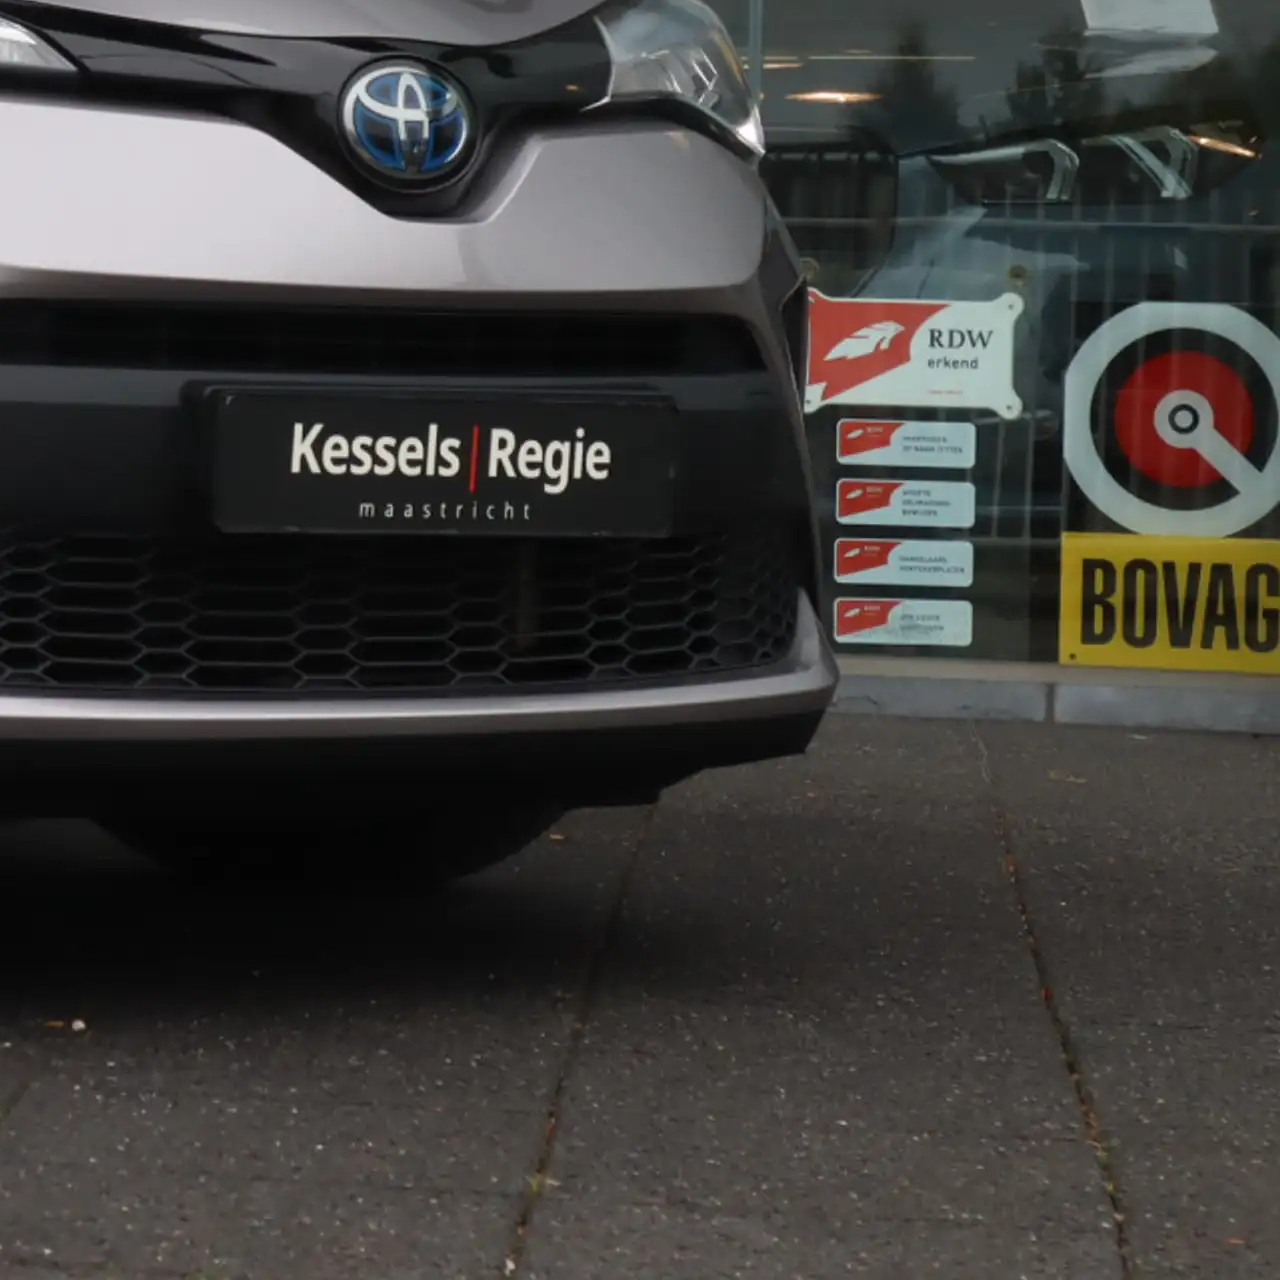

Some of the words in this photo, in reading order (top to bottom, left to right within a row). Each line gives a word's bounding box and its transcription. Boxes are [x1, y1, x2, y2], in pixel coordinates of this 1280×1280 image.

[927, 328, 993, 349] RDW
[927, 357, 979, 370] erkend
[290, 422, 461, 477] Kessels
[487, 426, 612, 495] Regie
[359, 500, 531, 521] maastricht
[1080, 558, 1280, 653] BOVAG
